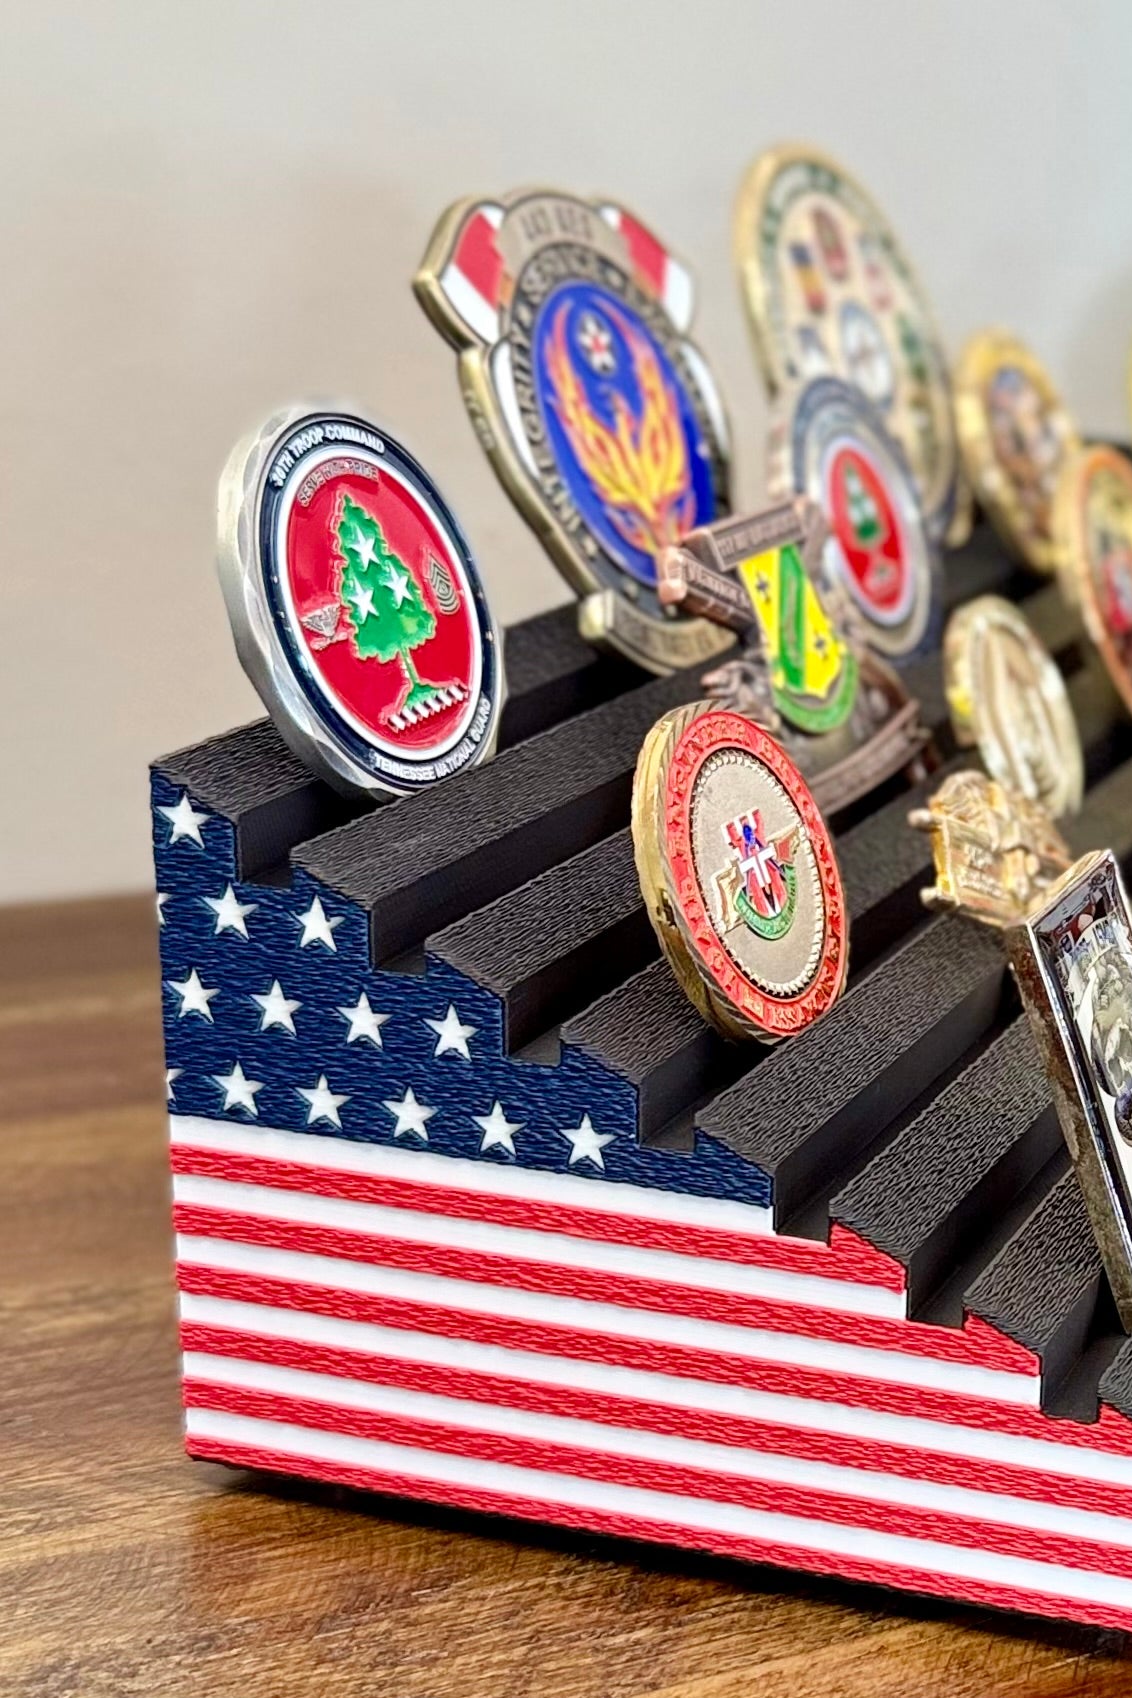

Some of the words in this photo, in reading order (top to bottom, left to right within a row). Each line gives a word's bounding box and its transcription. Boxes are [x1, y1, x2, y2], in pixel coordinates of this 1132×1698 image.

[287, 426, 324, 459] TROOP
[324, 424, 385, 455] COMMAND
[371, 750, 437, 781] TENNESSEE
[434, 736, 477, 779] NATIONAL
[470, 698, 491, 743] GUARD
